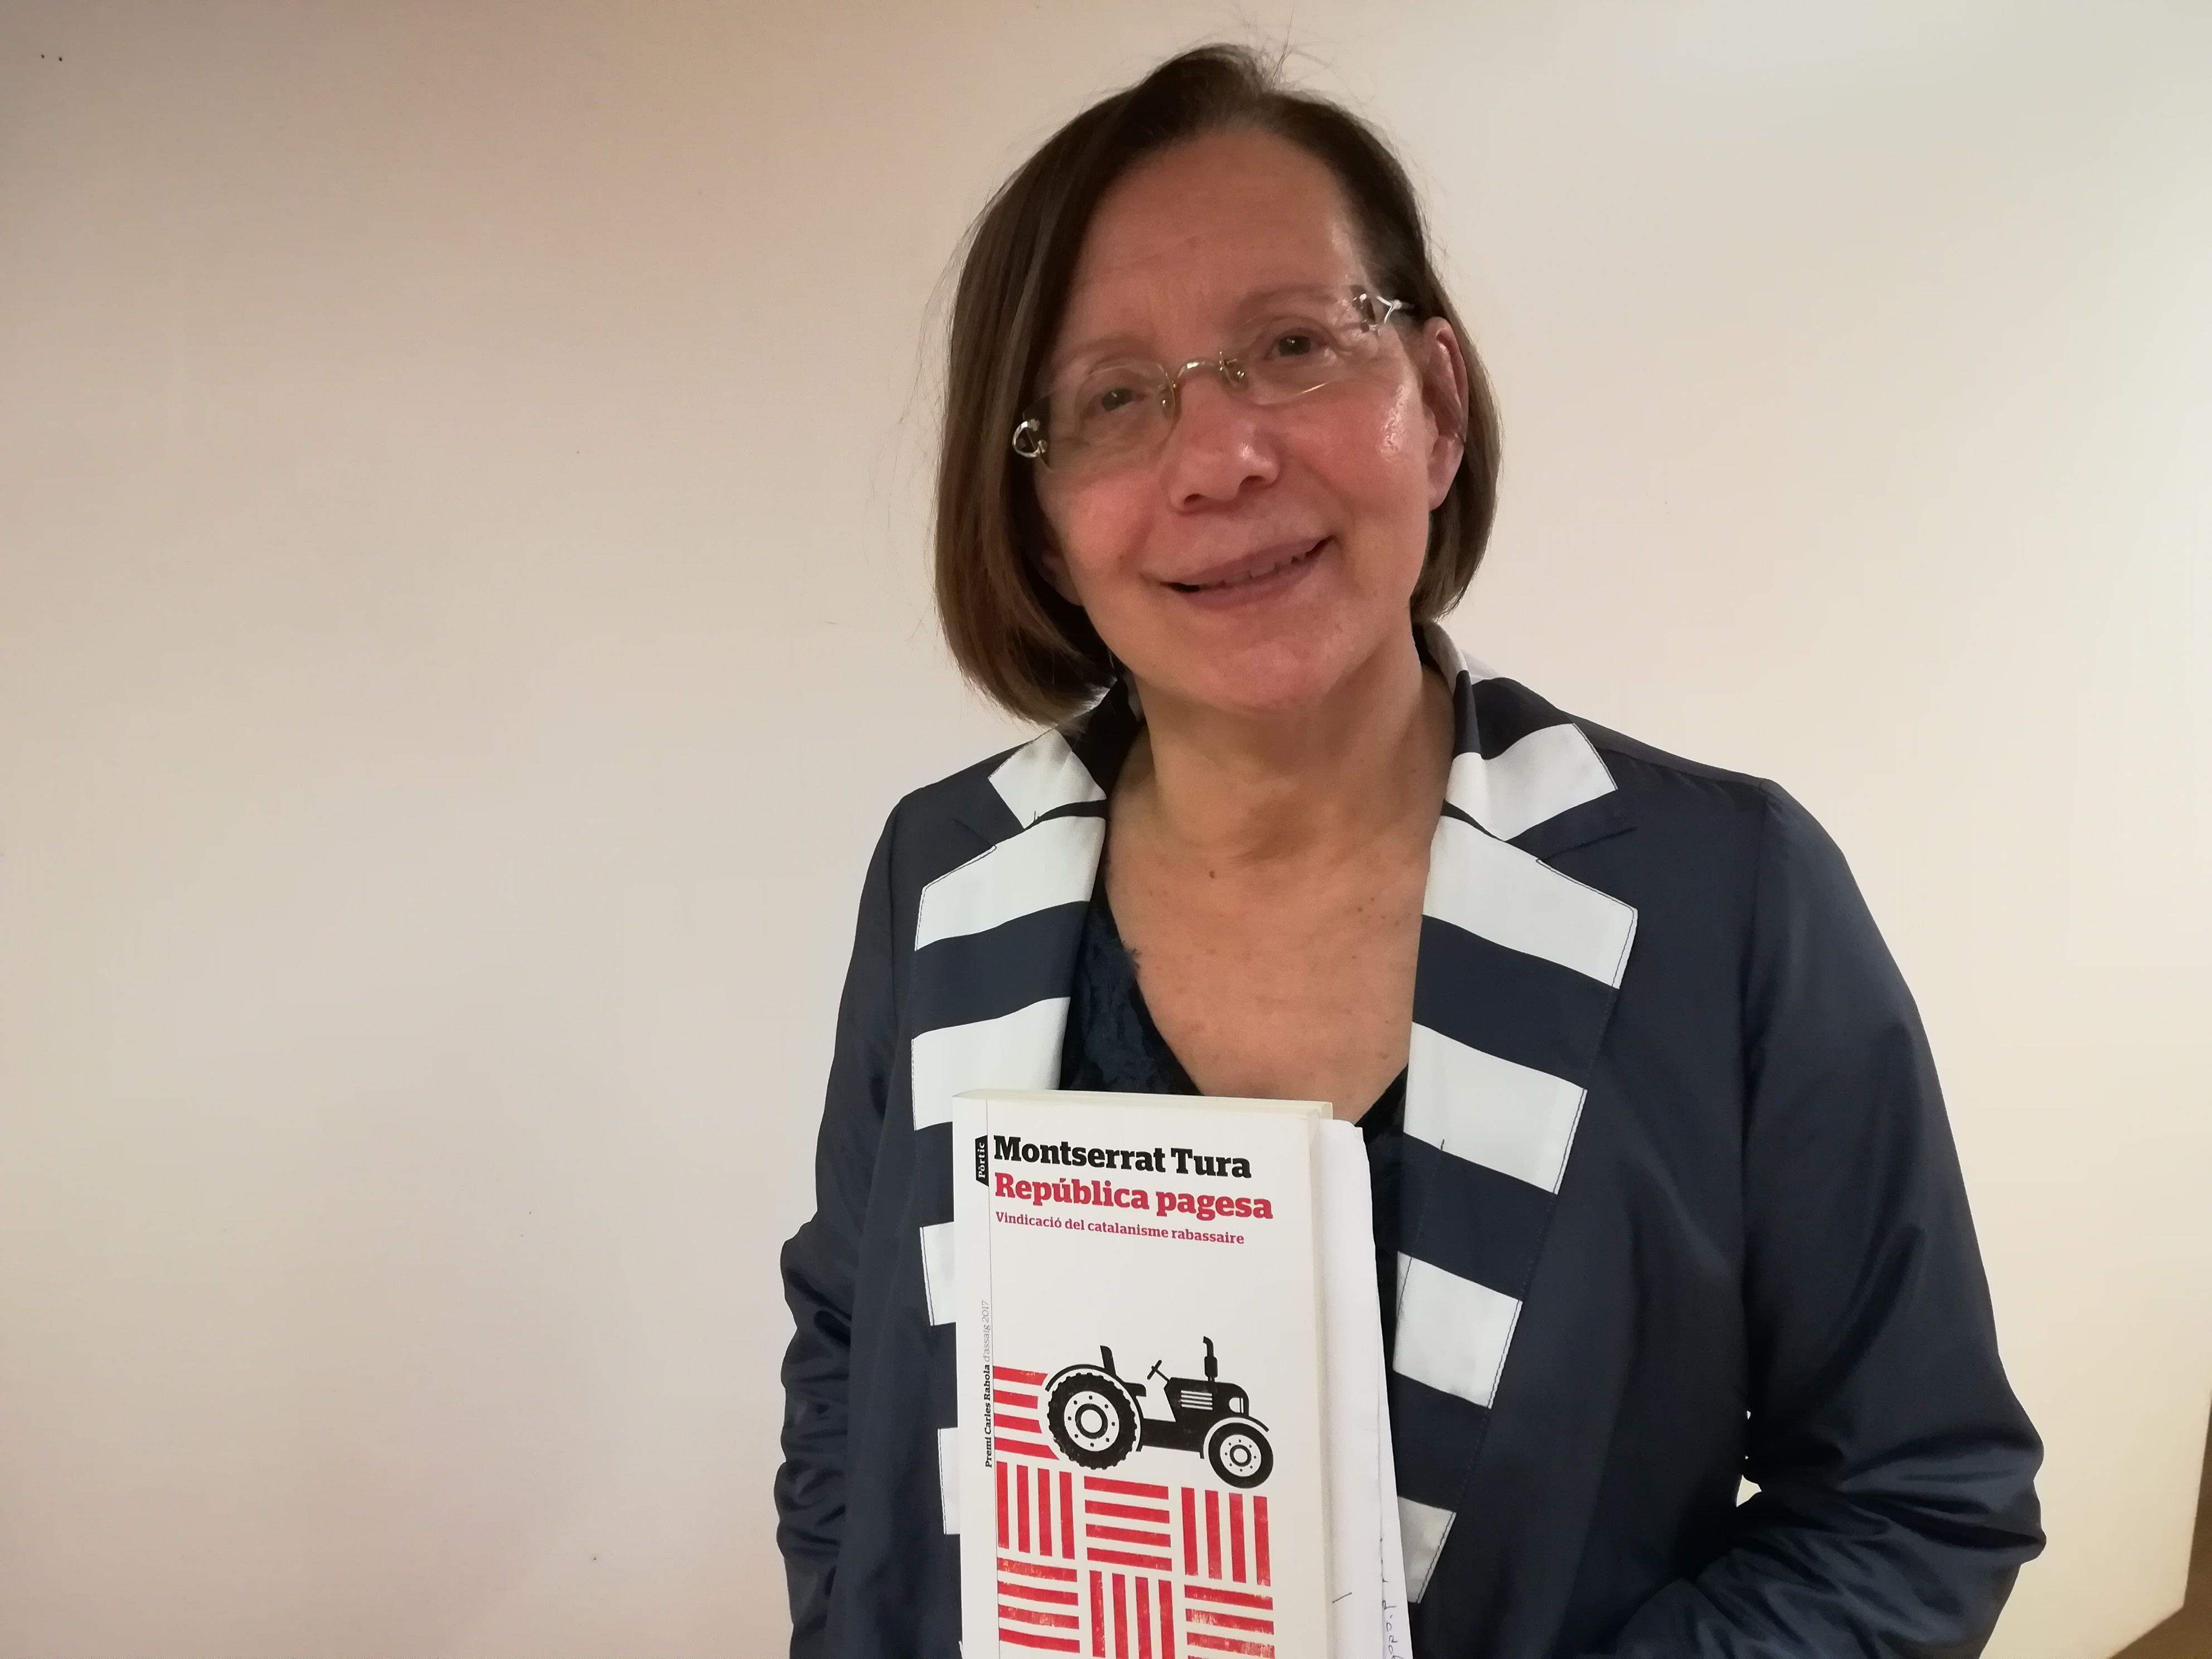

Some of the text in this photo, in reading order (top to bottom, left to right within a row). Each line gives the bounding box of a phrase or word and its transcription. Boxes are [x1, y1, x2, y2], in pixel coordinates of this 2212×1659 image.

[993, 1135, 1252, 1178] Montserrat Tura
[995, 1172, 1274, 1221] República pagesa
[995, 1211, 1244, 1244] Vindicació del catalanisme rabassaire
